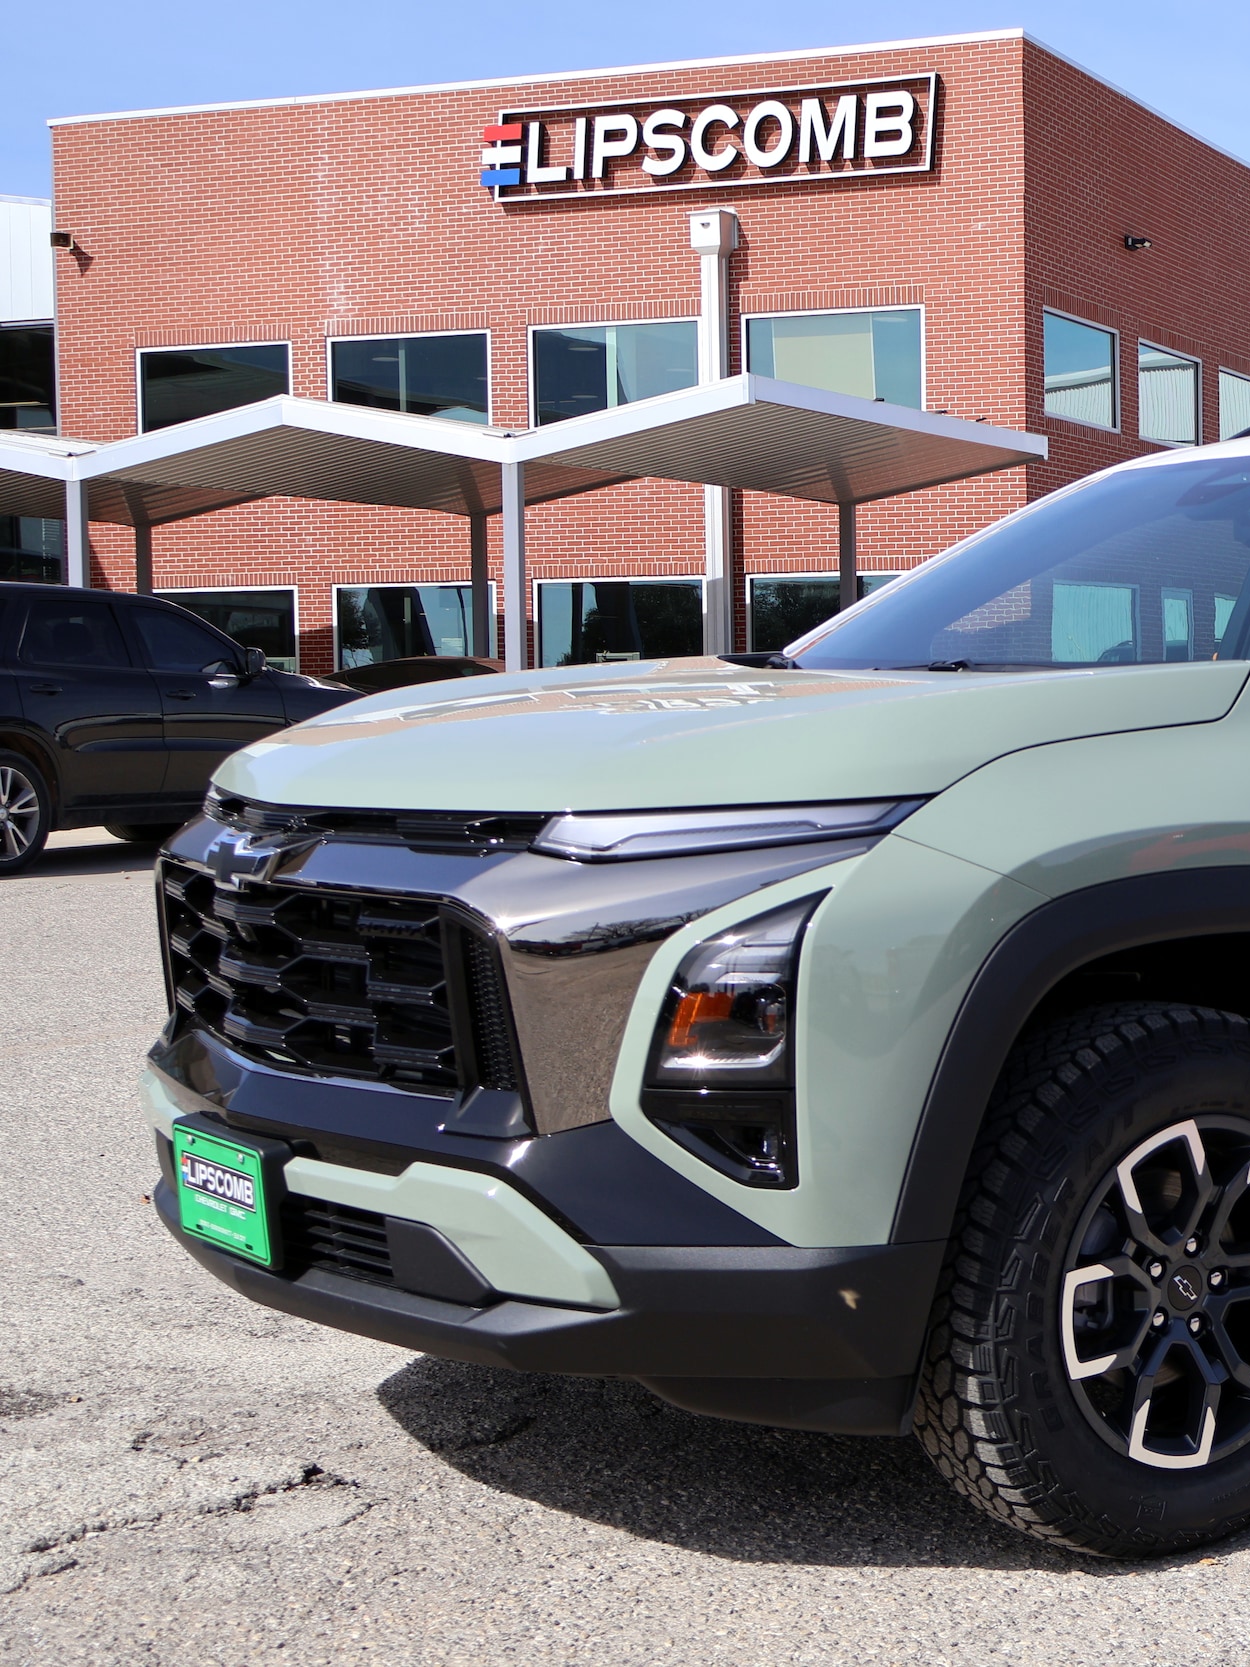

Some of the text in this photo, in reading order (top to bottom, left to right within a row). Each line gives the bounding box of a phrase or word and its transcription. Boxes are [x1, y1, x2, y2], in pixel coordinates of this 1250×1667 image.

[526, 89, 917, 184] LIPSCOMB
[186, 1158, 254, 1206] LIPSCOMB
[1025, 1176, 1077, 1433] GRABBER
